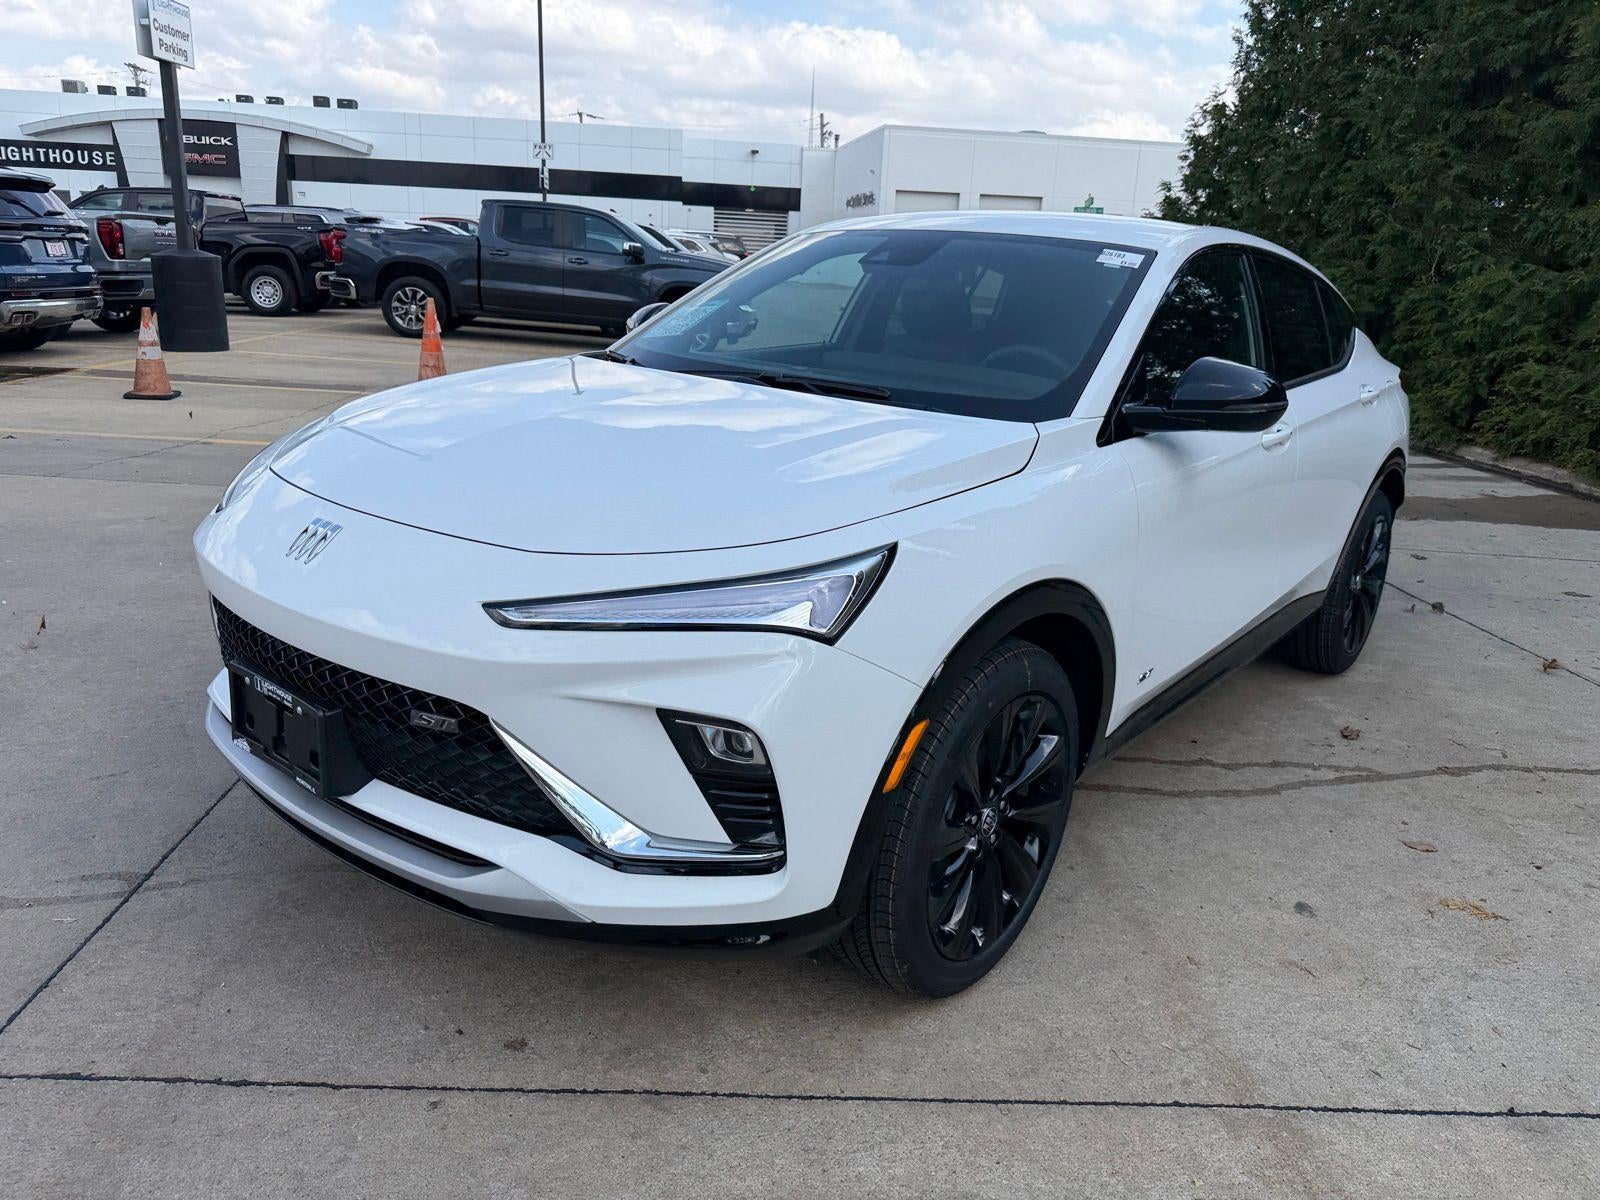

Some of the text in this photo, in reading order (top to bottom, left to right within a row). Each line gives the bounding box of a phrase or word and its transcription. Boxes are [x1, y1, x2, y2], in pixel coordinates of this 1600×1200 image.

[153, 18, 190, 42] Customer
[159, 38, 189, 62] Parking
[182, 135, 234, 146] BUICK
[0, 146, 116, 165] IGHTHOUSE
